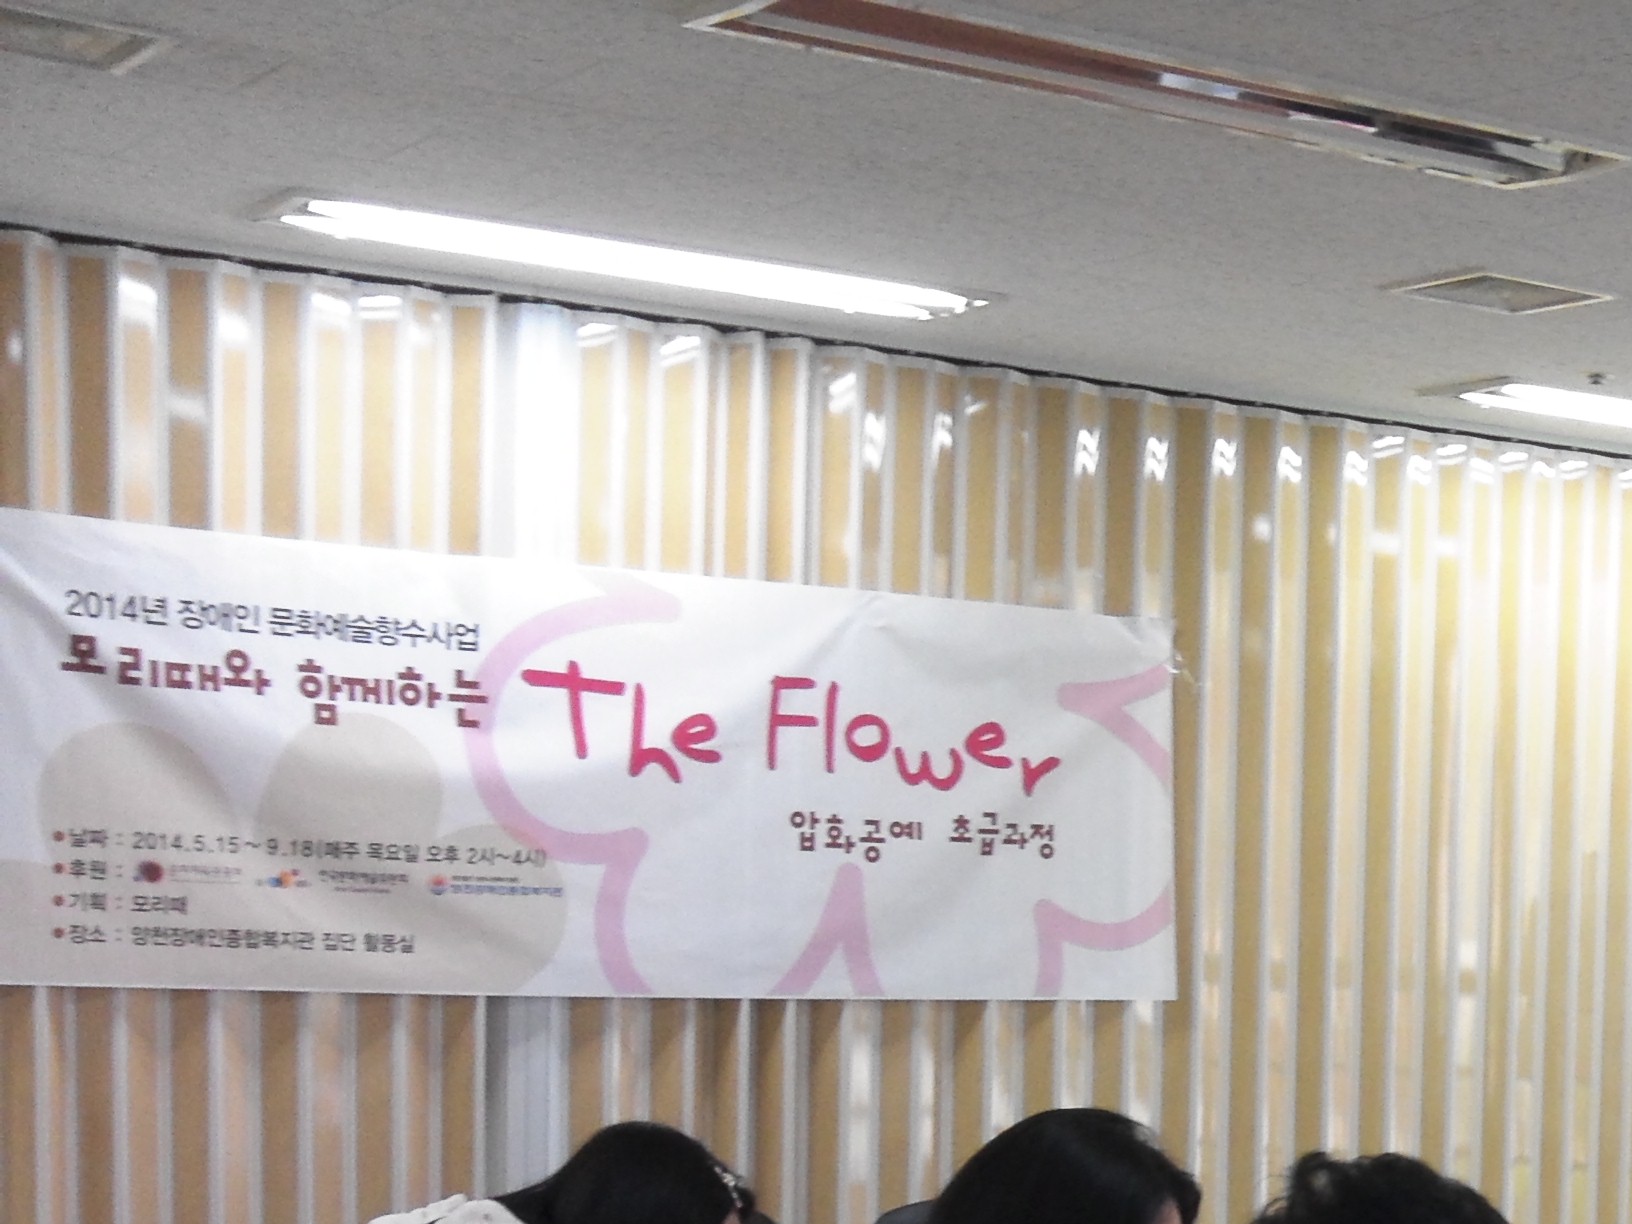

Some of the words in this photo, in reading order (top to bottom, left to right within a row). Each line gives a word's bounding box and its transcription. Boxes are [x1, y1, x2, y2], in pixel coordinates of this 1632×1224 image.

[63, 588, 168, 628] 2014년
[177, 599, 261, 634] 장애인
[268, 606, 480, 652] 문화예술향수사업
[296, 657, 489, 728] 함께하는
[521, 660, 722, 784] The
[766, 675, 1062, 797] Flower
[366, 842, 421, 864] 목요일
[425, 845, 459, 865] 오후
[790, 811, 923, 864] 압화공예
[948, 811, 1056, 861] 초급과정
[68, 858, 107, 880] 후원
[68, 892, 107, 912] 기획
[68, 924, 107, 945] 장소
[131, 925, 315, 950] 양천장애인종합복지관
[322, 932, 356, 952] 집단
[363, 933, 415, 954] 활동실
